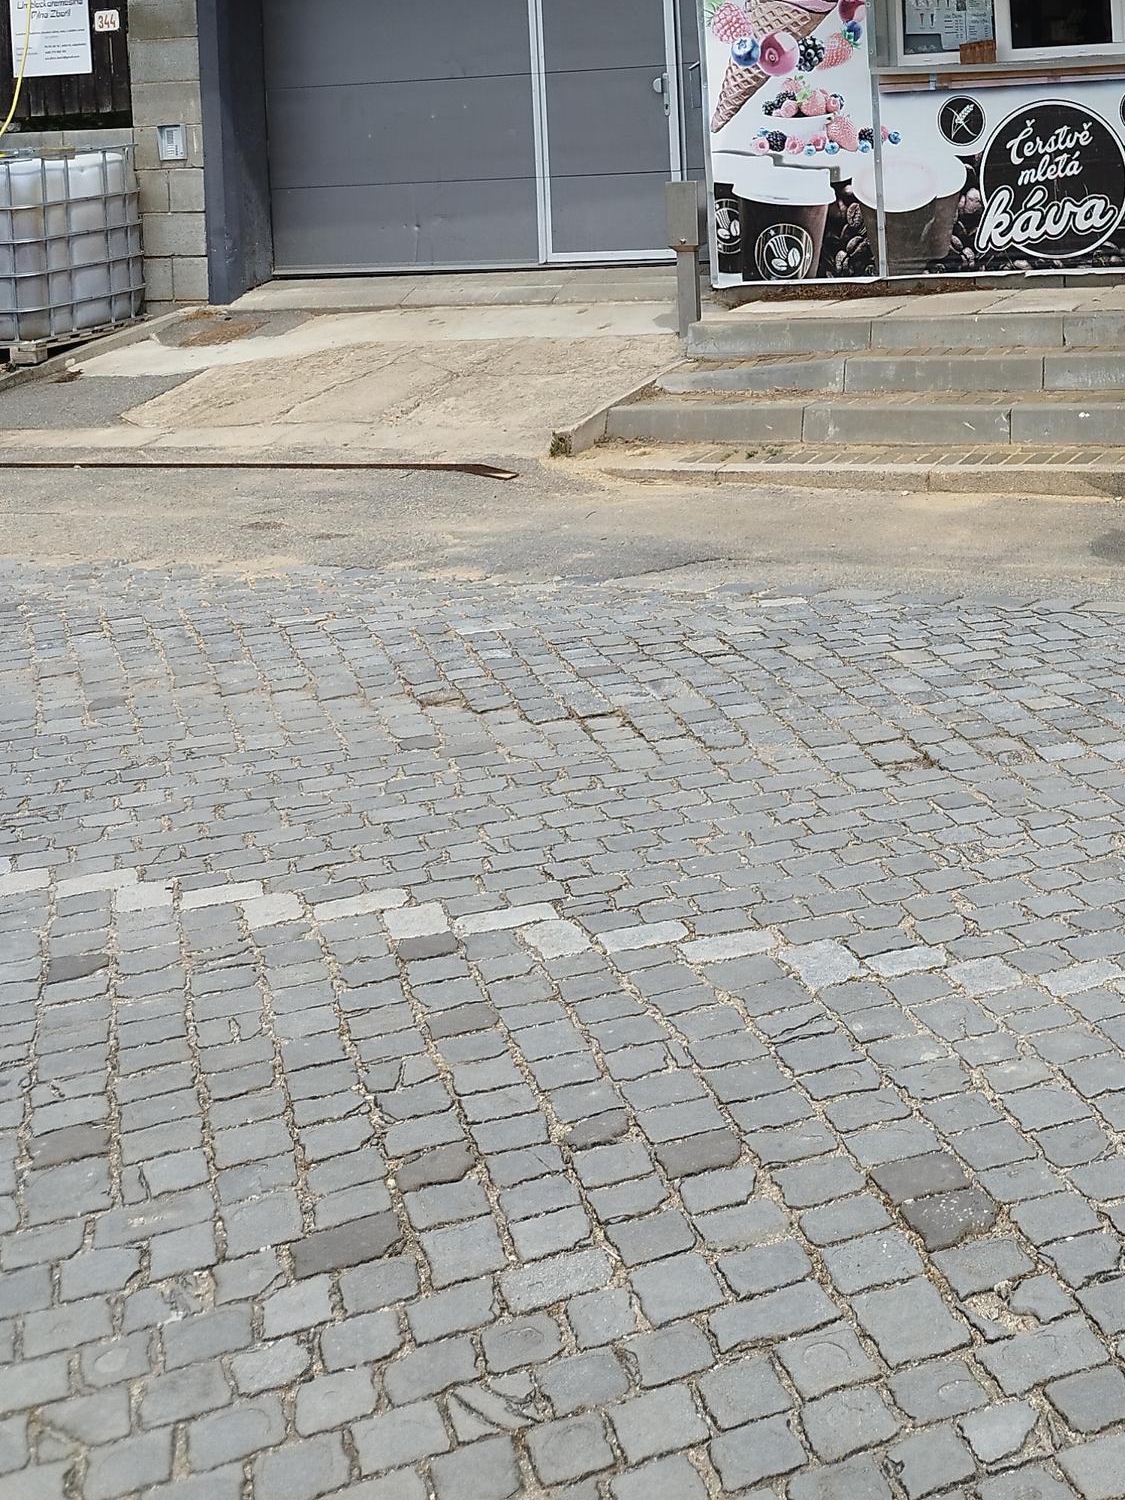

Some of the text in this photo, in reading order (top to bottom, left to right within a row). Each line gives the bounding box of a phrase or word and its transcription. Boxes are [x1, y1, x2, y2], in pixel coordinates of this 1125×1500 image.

[98, 14, 116, 29] 344
[1006, 118, 1094, 166] Čerstvě
[1017, 151, 1083, 187] mletá
[975, 186, 1117, 252] káva
